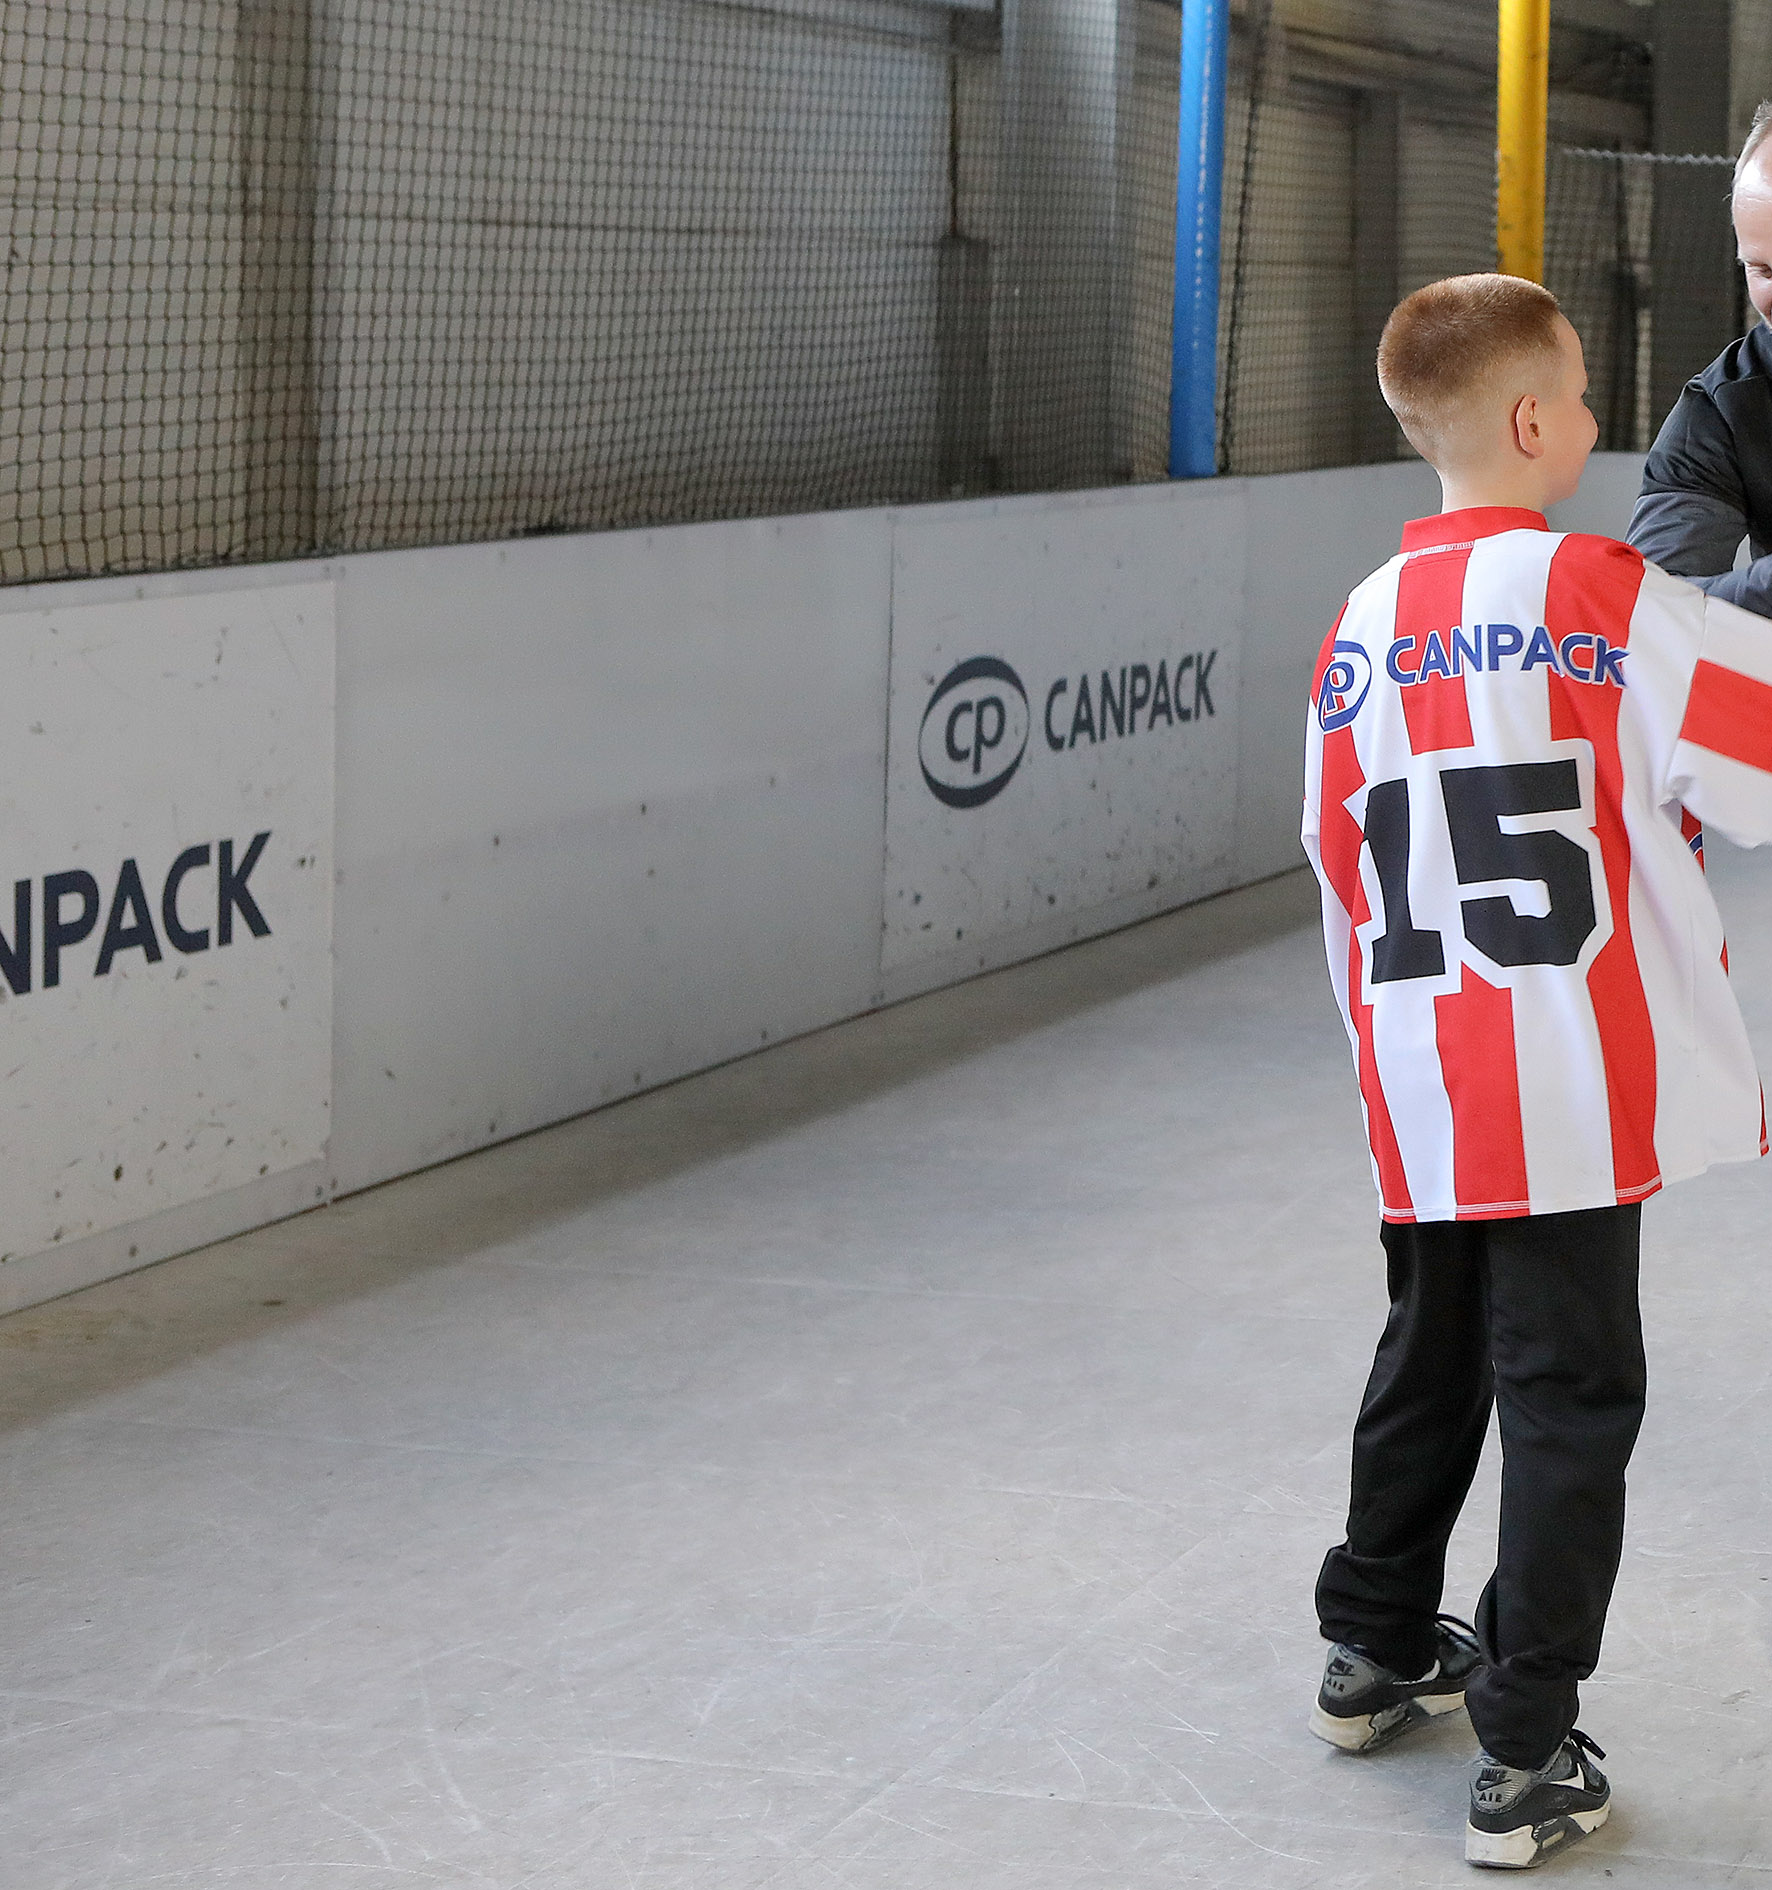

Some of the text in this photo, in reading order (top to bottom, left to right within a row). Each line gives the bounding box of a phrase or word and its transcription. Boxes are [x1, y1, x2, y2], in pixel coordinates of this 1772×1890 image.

[1387, 624, 1629, 687] CANPACK
[1045, 650, 1217, 751] CANPACK
[1363, 758, 1597, 985] 15
[1479, 1791, 1502, 1803] AIR
